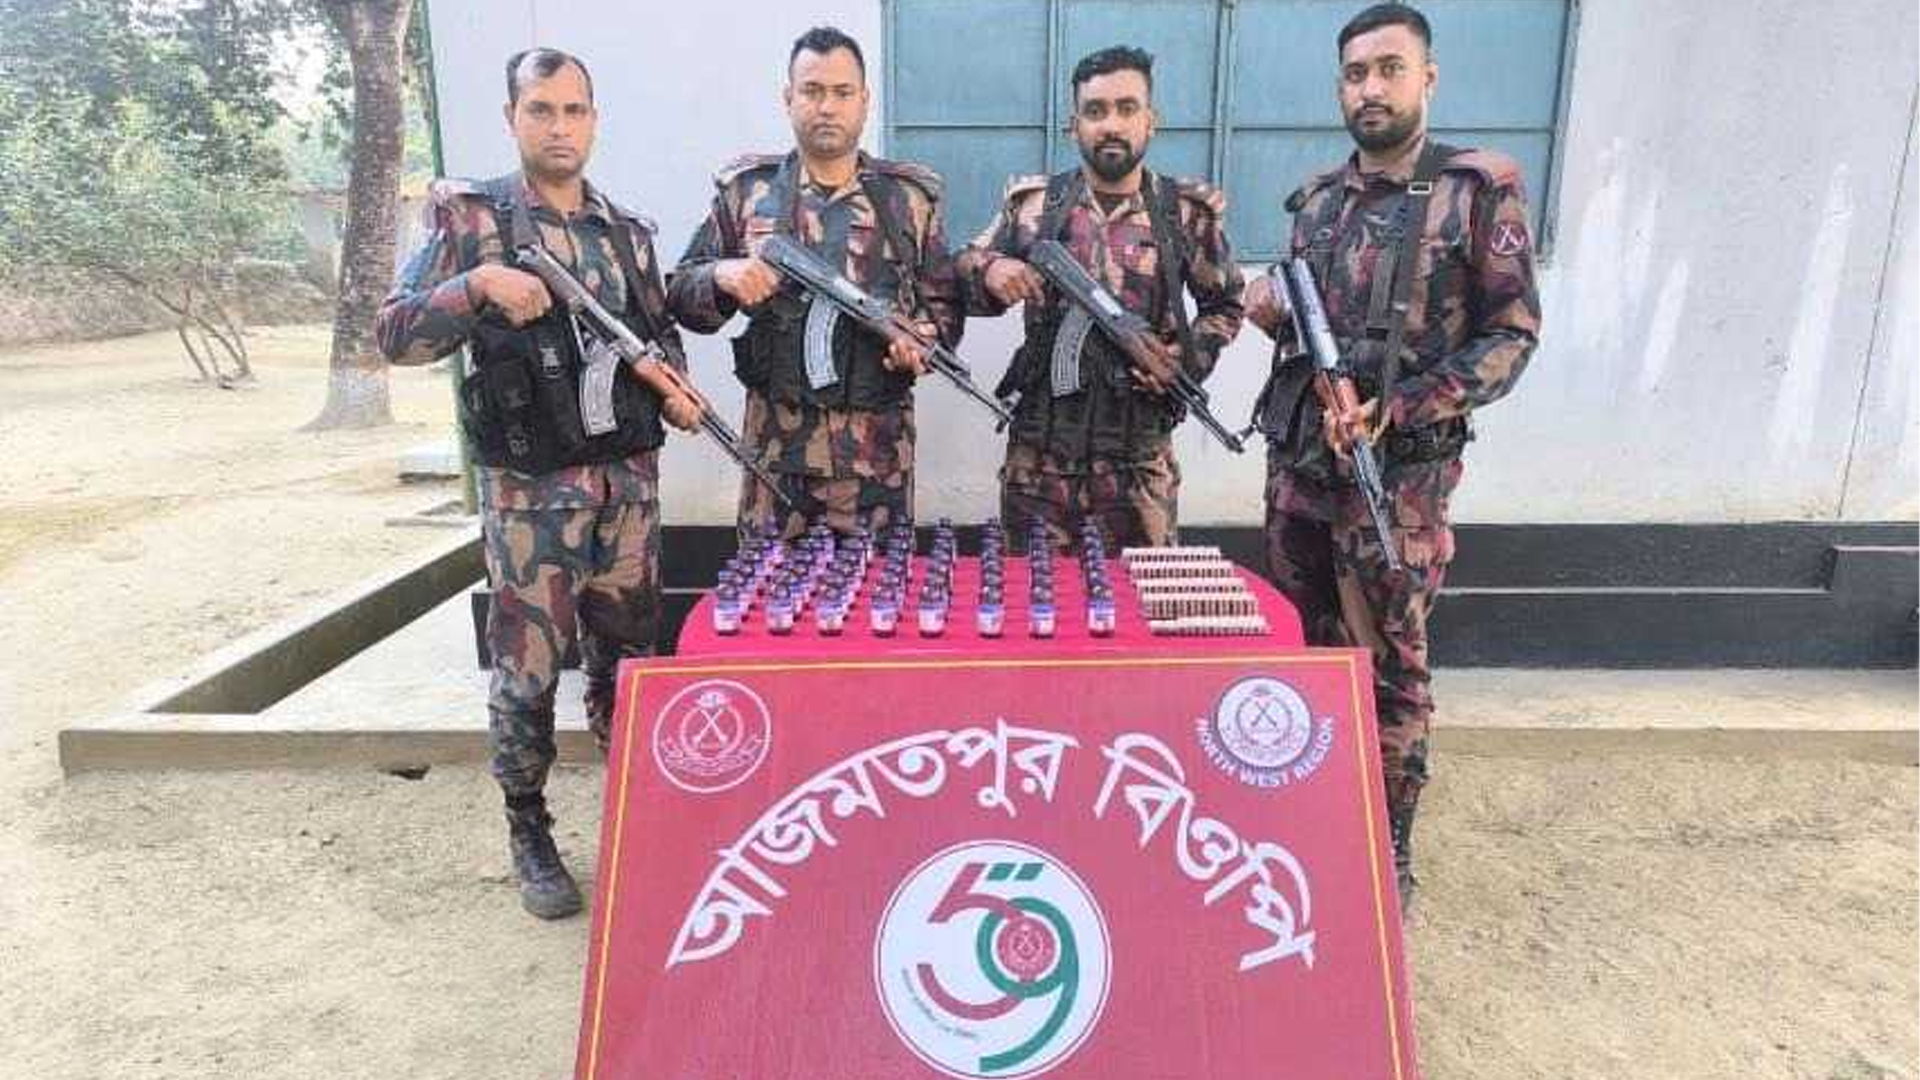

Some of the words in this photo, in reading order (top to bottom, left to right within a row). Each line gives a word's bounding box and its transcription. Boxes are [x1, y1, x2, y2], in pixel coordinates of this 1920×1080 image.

[1239, 768, 1290, 787] WEST
[1293, 713, 1335, 780] REGION
[666, 717, 1080, 969] আজমতপুর
[1093, 733, 1316, 970] বিওপি
